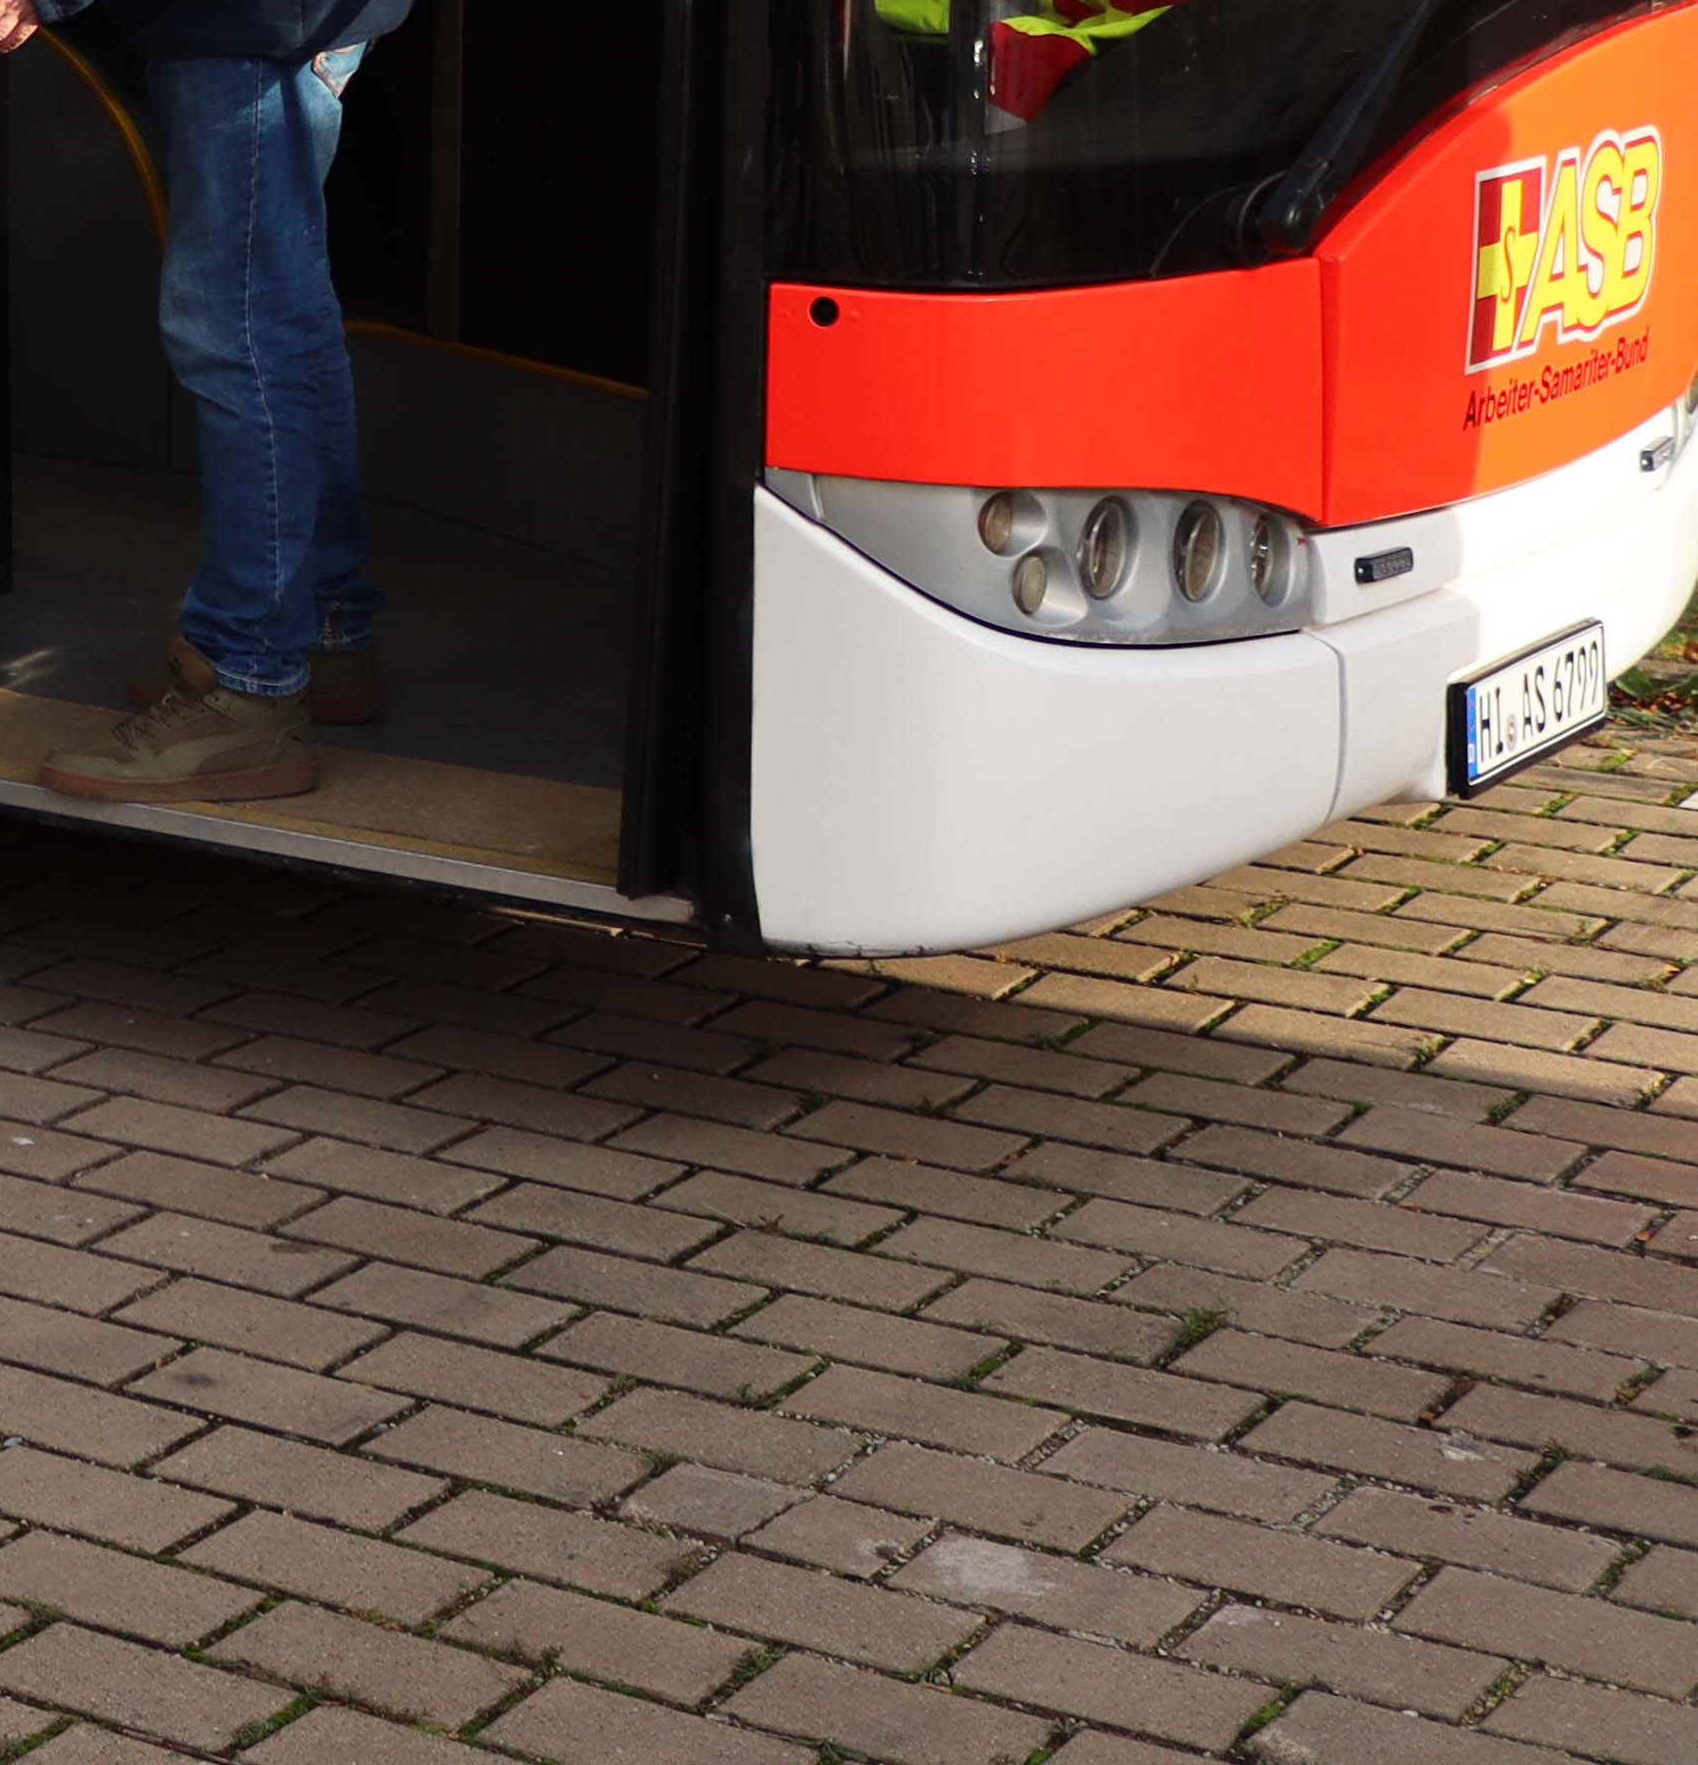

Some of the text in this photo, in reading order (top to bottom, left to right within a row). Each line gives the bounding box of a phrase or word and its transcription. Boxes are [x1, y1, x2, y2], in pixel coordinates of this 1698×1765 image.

[1516, 127, 1661, 352] ASB
[1462, 327, 1650, 431] Arbeiter-Samariter-Bund
[1479, 687, 1504, 764] HI
[1522, 664, 1547, 741] AS
